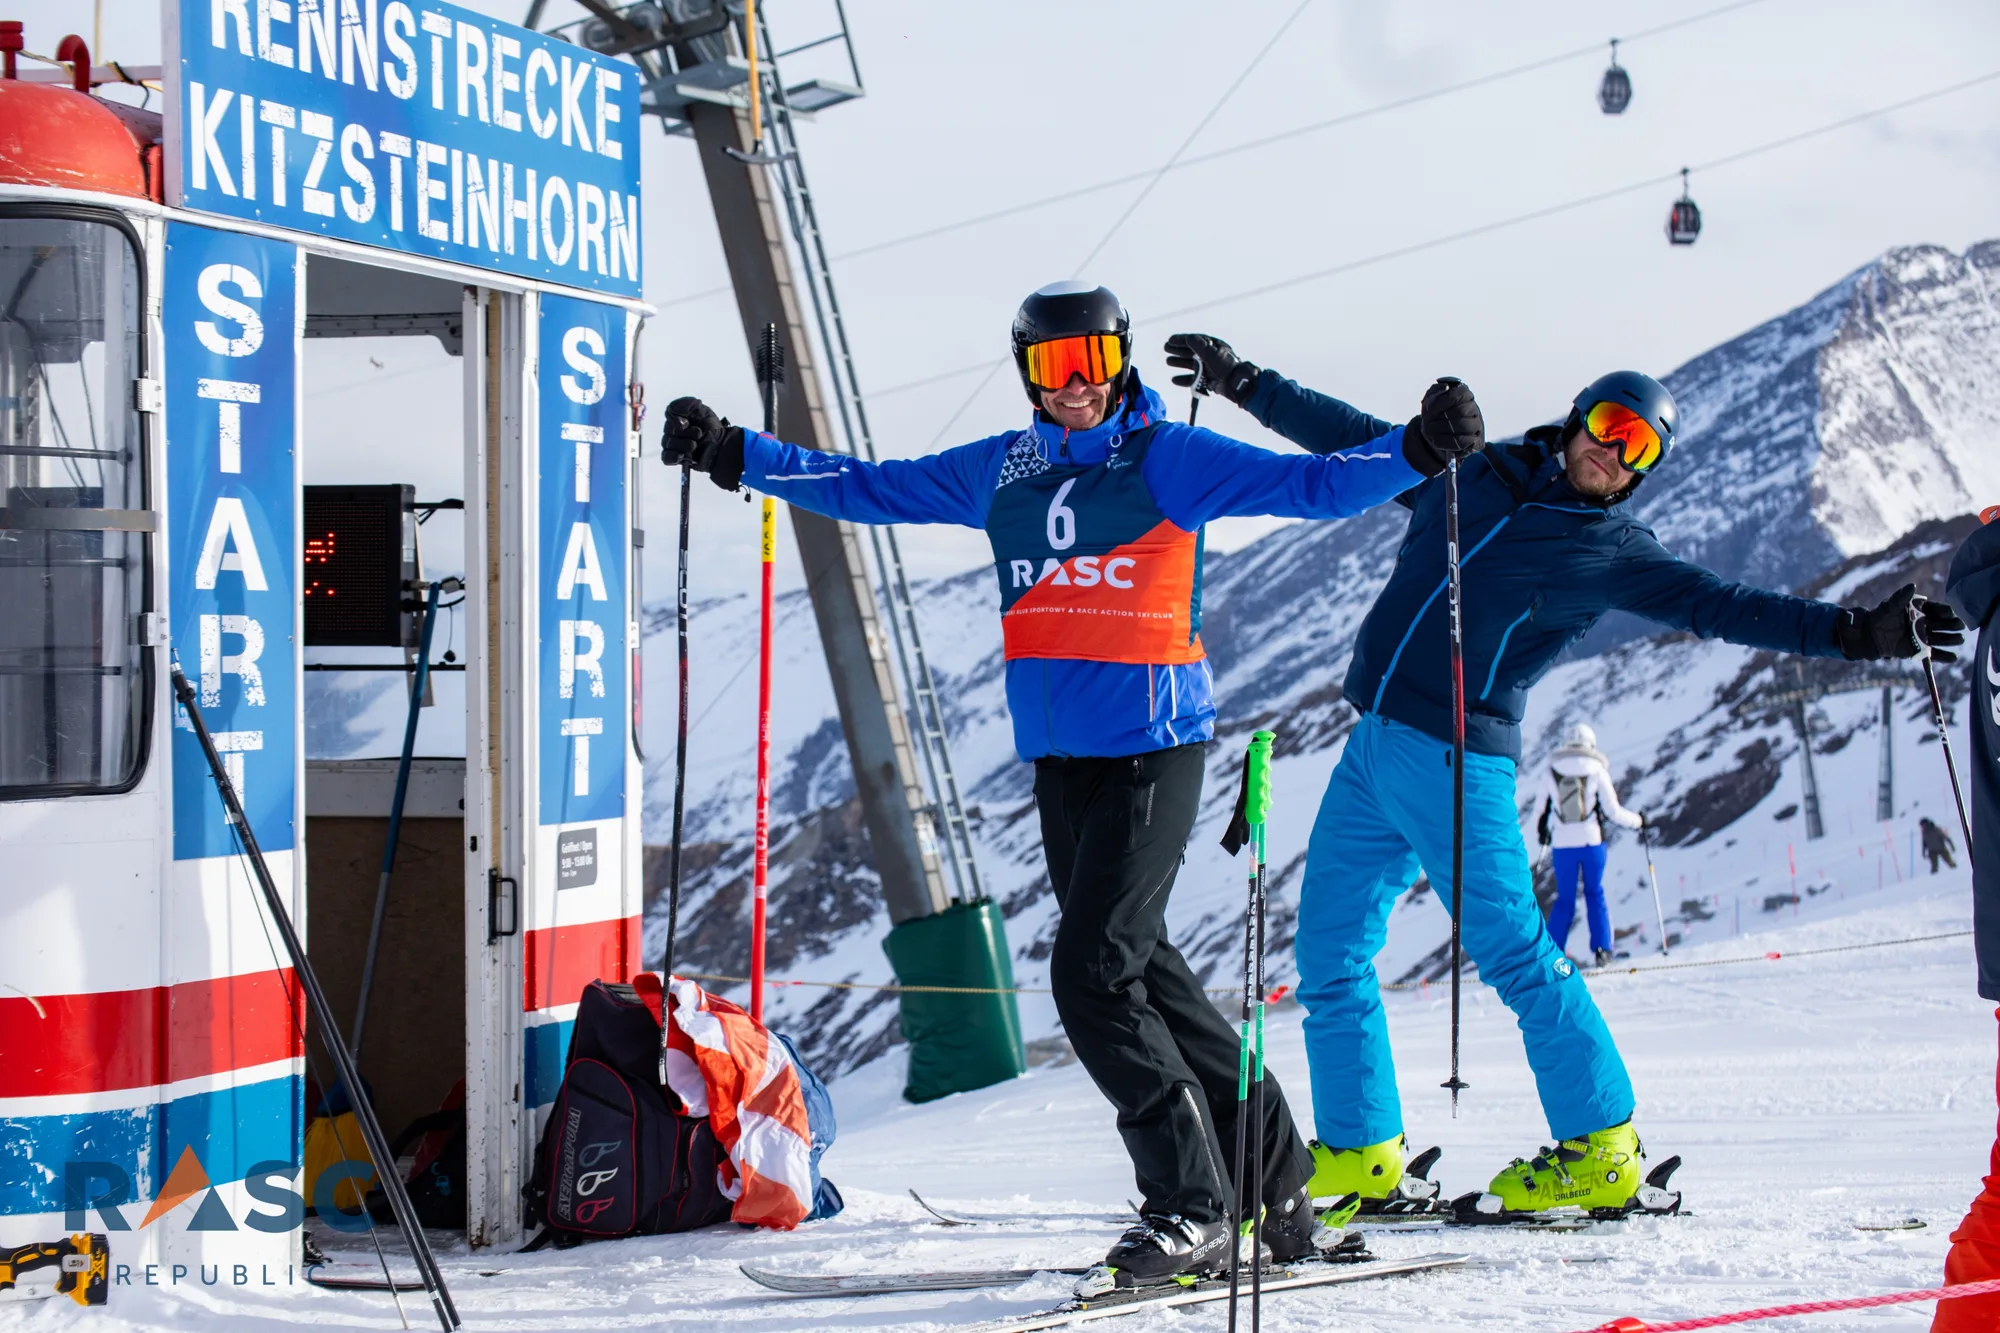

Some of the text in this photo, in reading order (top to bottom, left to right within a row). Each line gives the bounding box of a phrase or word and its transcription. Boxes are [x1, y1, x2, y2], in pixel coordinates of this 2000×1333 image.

[190, 81, 638, 282] KITZSTEINHORN
[1047, 478, 1076, 550] 6
[195, 264, 269, 824] START
[556, 326, 608, 796] START
[1010, 556, 1136, 589] RASC
[1100, 609, 1134, 617] ACTION
[1145, 782, 1155, 826] PERFORMANCE
[1555, 1188, 1591, 1202] DALBELLO
